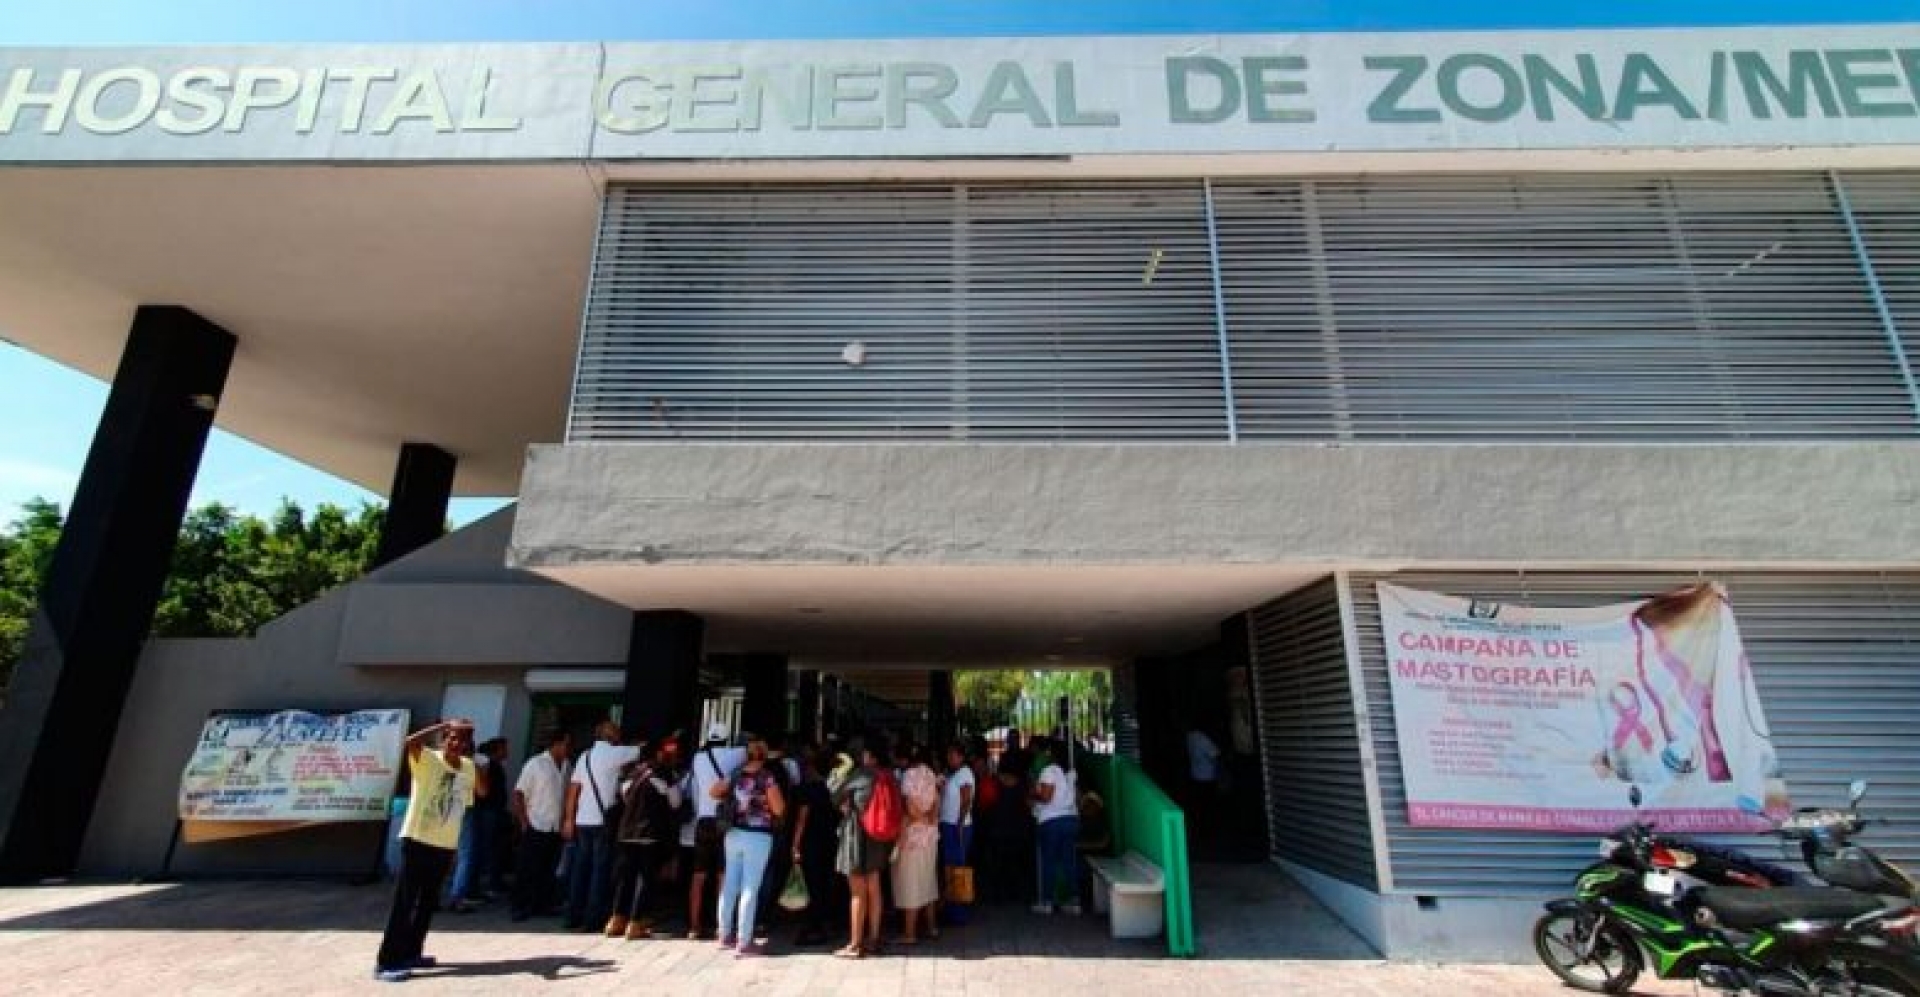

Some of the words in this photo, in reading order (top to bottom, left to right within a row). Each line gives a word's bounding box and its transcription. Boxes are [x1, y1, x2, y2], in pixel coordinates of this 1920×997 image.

[0, 67, 522, 135] HOSPITAL
[594, 59, 1121, 135] GENERAL
[1165, 55, 1318, 123] DE
[1362, 48, 1920, 123] ZONA/ME
[1398, 630, 1536, 658] CAMPAÑA
[1543, 640, 1579, 658] DE
[1396, 659, 1596, 688] MASTOGRAFÍA
